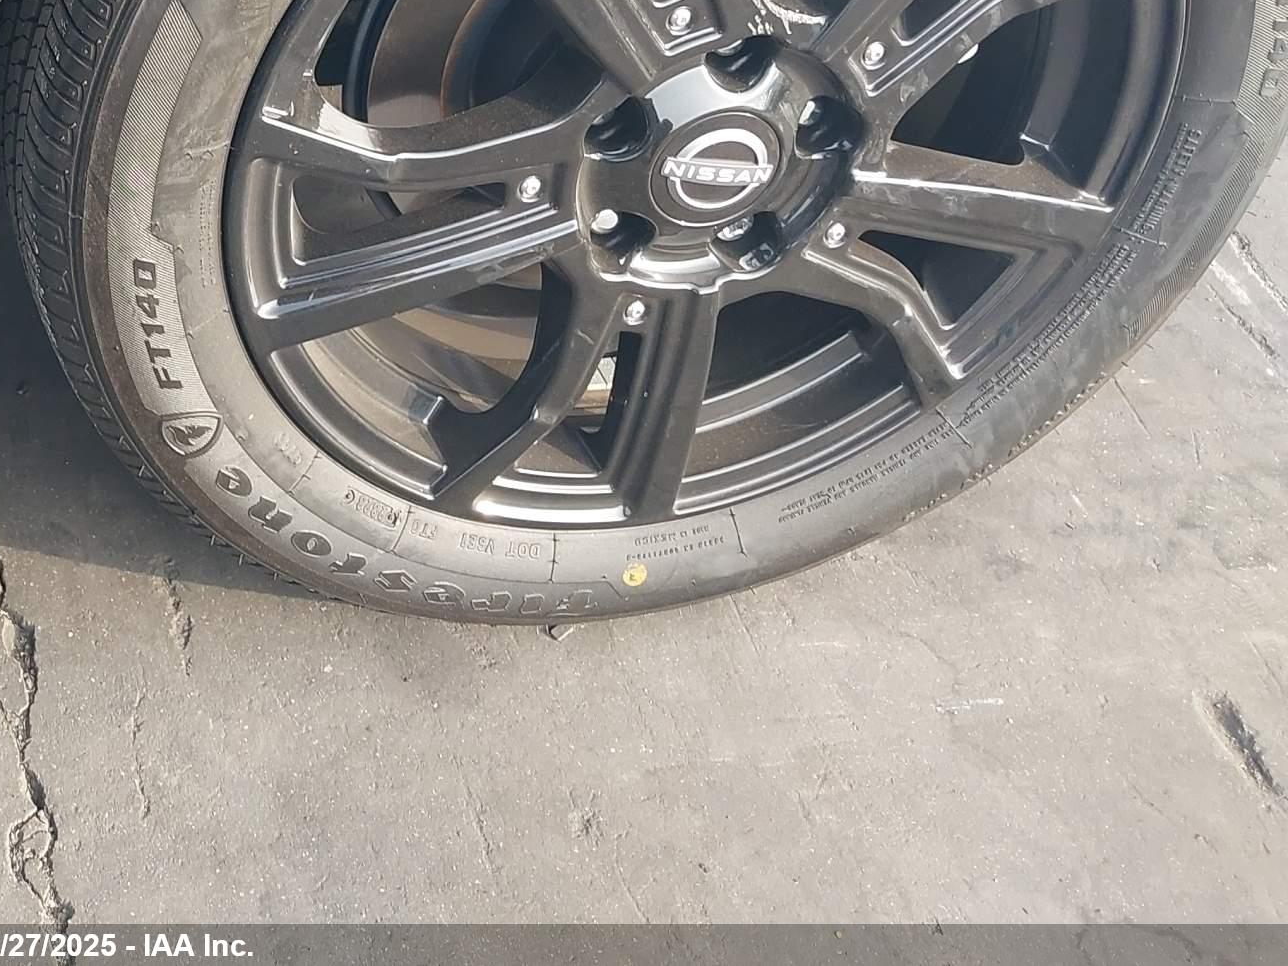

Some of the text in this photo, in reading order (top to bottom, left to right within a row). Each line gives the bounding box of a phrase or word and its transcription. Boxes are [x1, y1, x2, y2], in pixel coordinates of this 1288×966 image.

[665, 160, 774, 184] NISSAN
[132, 257, 184, 392] FT140
[506, 534, 541, 560] DOT
